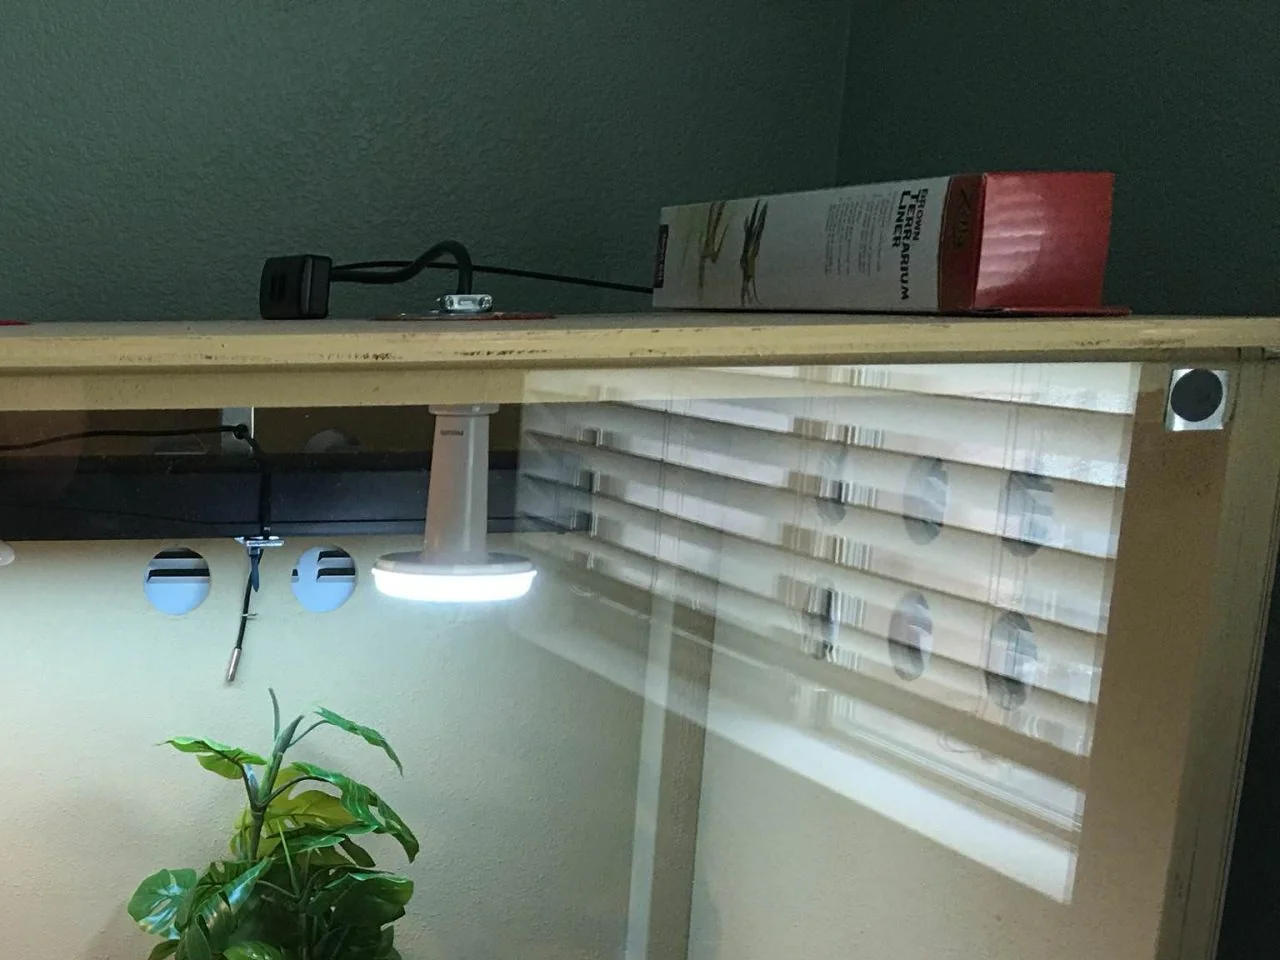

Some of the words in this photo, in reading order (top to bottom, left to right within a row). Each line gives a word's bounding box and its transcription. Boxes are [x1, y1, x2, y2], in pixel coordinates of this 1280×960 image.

[892, 190, 911, 248] LINER
[912, 188, 929, 241] BROWN
[900, 190, 921, 300] TERRARIUM
